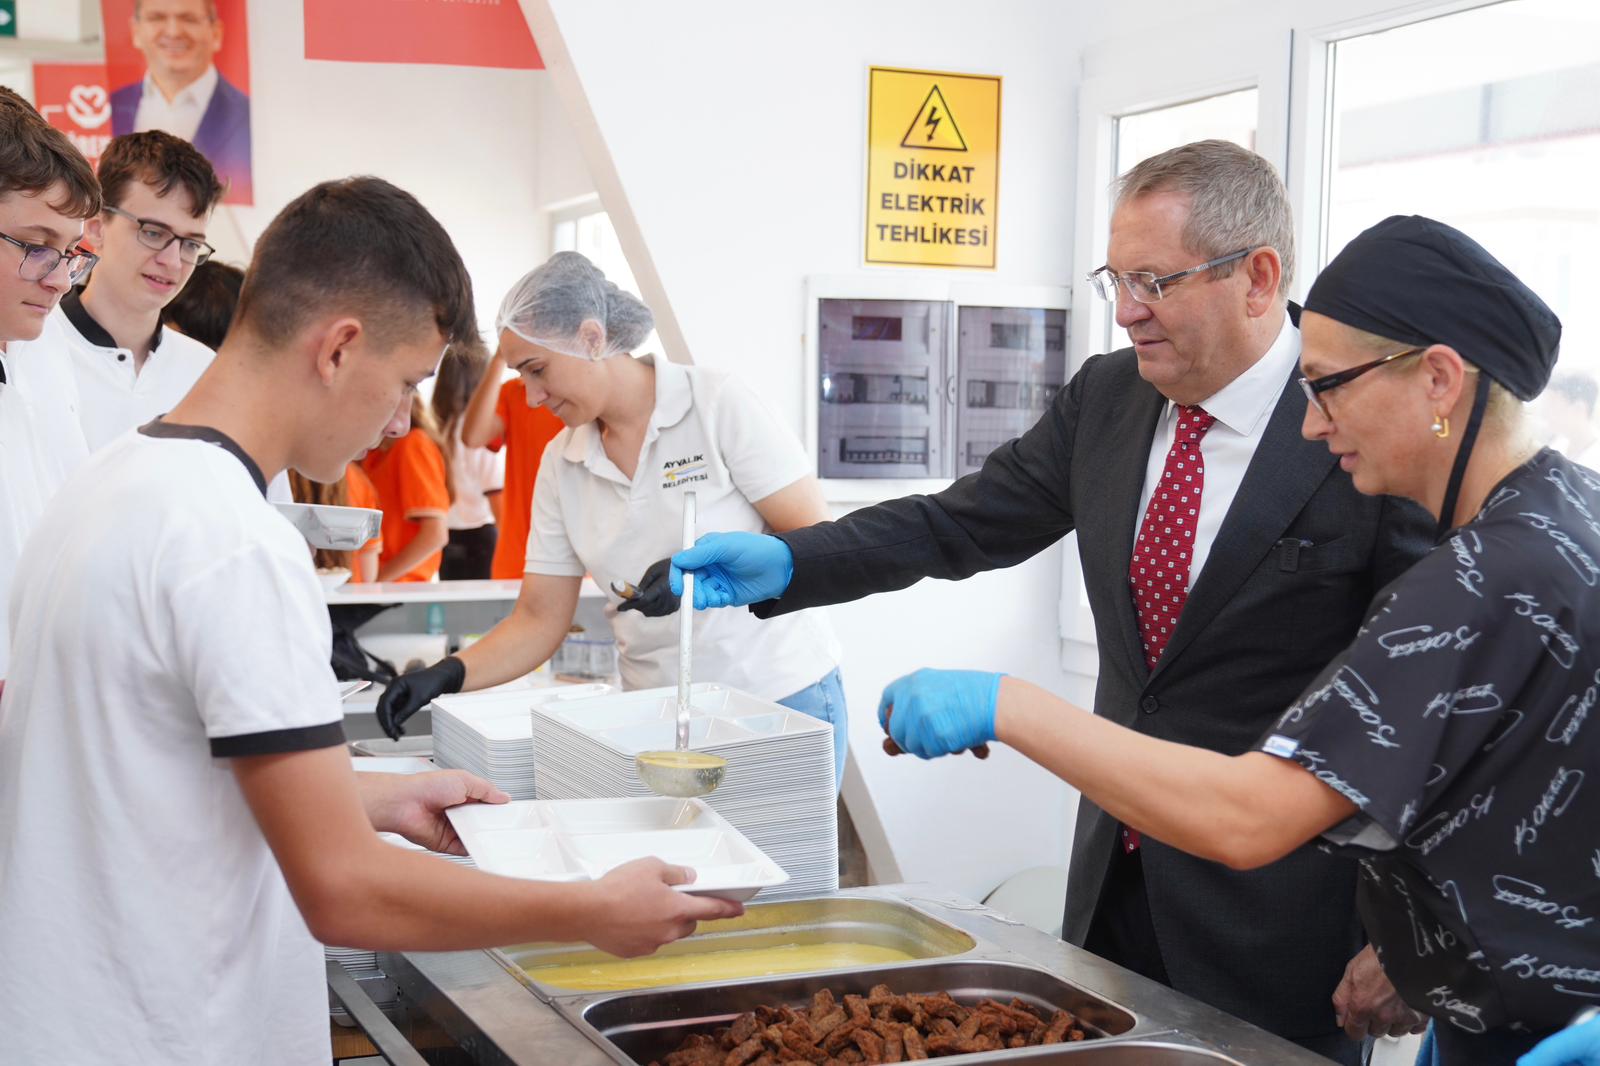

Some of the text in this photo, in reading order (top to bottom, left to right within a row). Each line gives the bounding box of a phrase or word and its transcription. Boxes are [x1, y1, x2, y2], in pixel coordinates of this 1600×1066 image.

[893, 158, 975, 184] DİKKAT
[880, 192, 985, 216] ELEKTRİK
[876, 222, 989, 247] TEHLİKESİ
[663, 454, 704, 469] AYVALIK
[662, 473, 708, 489] BELEDİYESİ
